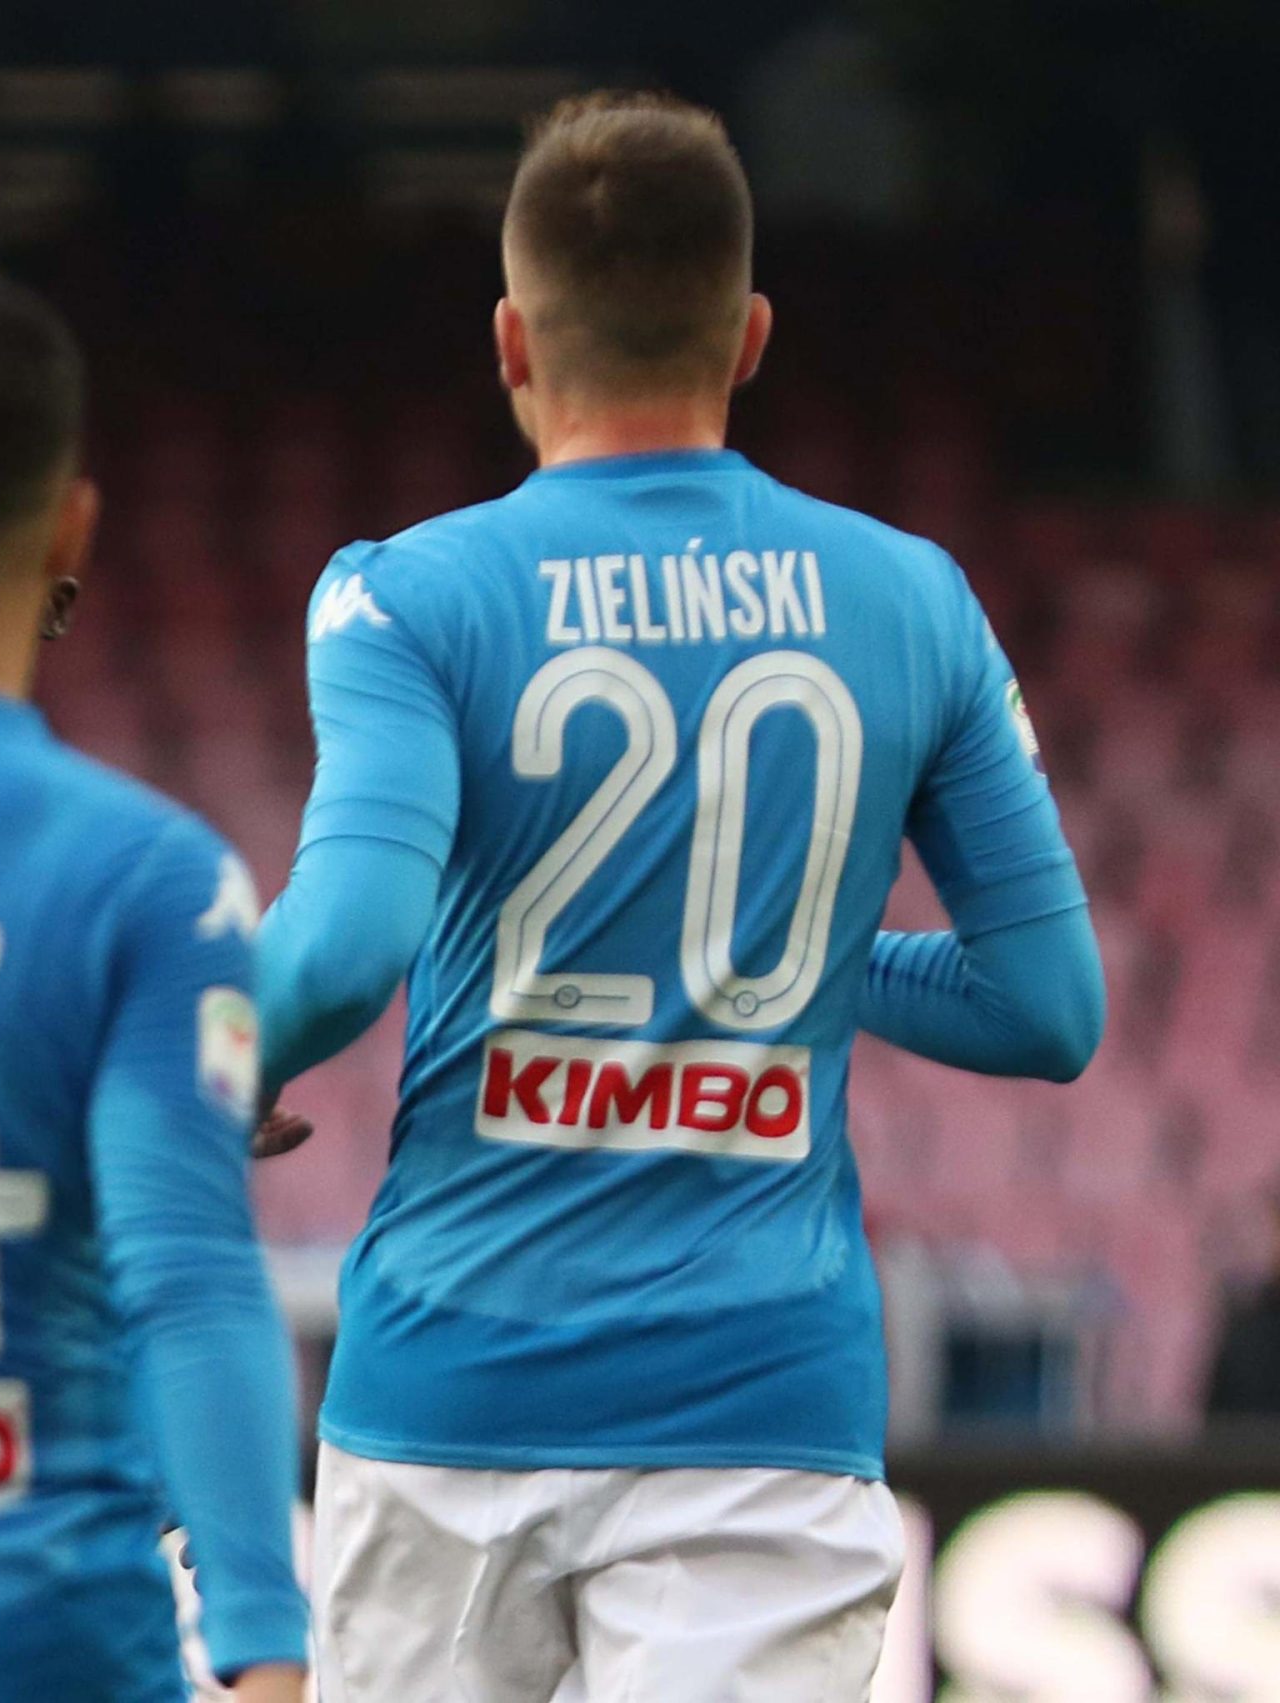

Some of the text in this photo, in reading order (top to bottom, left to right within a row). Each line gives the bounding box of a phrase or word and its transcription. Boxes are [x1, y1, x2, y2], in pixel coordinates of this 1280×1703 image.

[538, 538, 826, 645] ZIELIŃSKI
[489, 646, 863, 1031] 20
[482, 1048, 803, 1140] KIMBO
